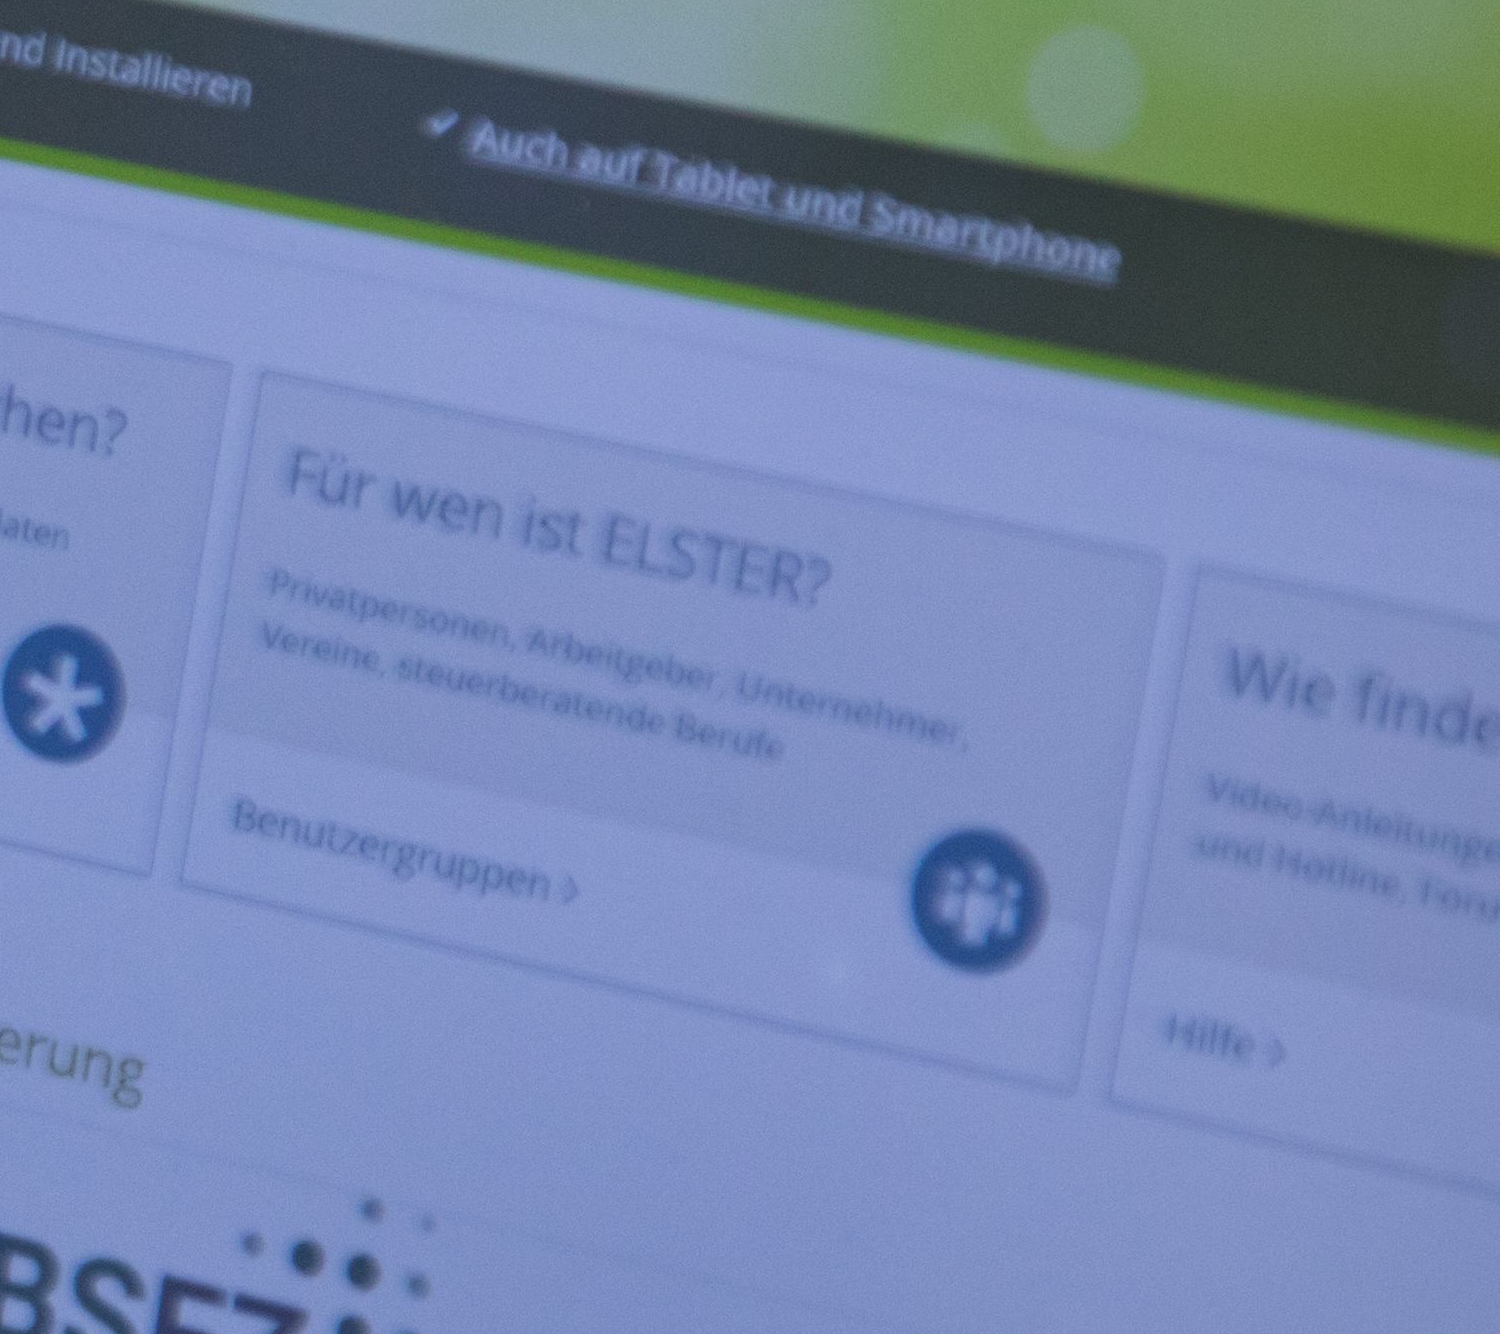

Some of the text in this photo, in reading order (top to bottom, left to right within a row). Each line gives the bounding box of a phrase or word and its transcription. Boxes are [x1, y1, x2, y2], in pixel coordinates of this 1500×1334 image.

[53, 38, 254, 108] Installieren
[468, 121, 1120, 280] Auch auf Tablet und Smartphone
[284, 445, 833, 610] Für wen ist ELSTER?
[258, 620, 785, 762] Vereine, steuerberatende Berufe
[263, 566, 516, 655] Privatpersonen,
[525, 626, 727, 698] Arbeitgeber,
[1220, 644, 1336, 717] Wie
[228, 795, 552, 904] Benutzergruppen
[1160, 1011, 1255, 1063] Hilfe
